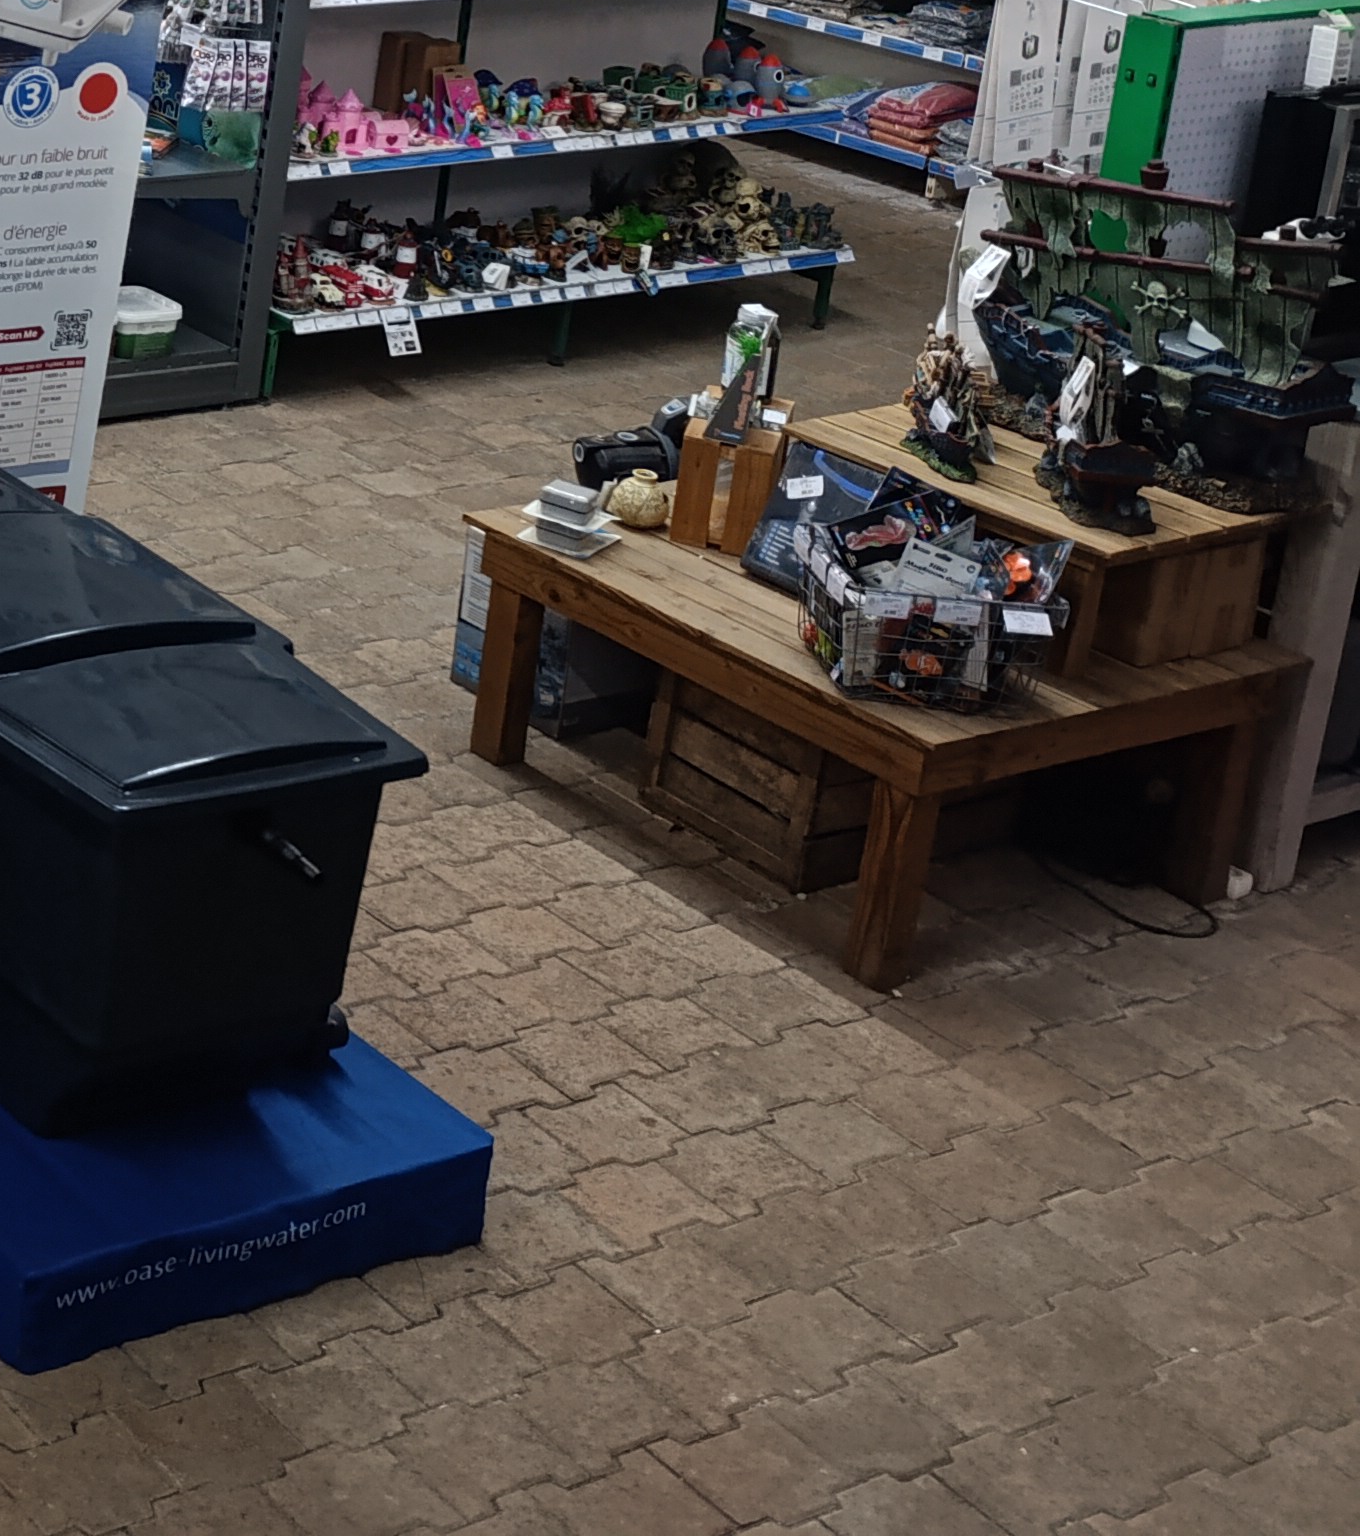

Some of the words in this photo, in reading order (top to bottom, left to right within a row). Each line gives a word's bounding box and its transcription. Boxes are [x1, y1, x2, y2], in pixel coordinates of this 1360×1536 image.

[21, 82, 41, 111] 3
[20, 153, 38, 165] un
[40, 146, 75, 164] faible
[77, 145, 109, 161] bruit
[17, 171, 30, 181] 32
[31, 170, 44, 180] dB
[44, 169, 65, 181] pour
[65, 167, 73, 178] le
[73, 166, 92, 179] plus
[93, 166, 115, 177] petit
[0, 184, 21, 196] pour
[22, 183, 31, 194] le
[32, 182, 49, 195] plus
[50, 180, 75, 194] grand
[76, 179, 108, 190] modèle
[3, 221, 68, 242] d'énergie
[4, 244, 55, 256] consomment
[85, 240, 98, 249] 50
[46, 253, 98, 265] accumulation
[32, 267, 56, 278] durée
[56, 266, 67, 276] de
[68, 265, 80, 274] vie
[81, 264, 97, 274] des
[23, 328, 39, 339] Me
[55, 1201, 368, 1310] www.oase-livingwater.com
